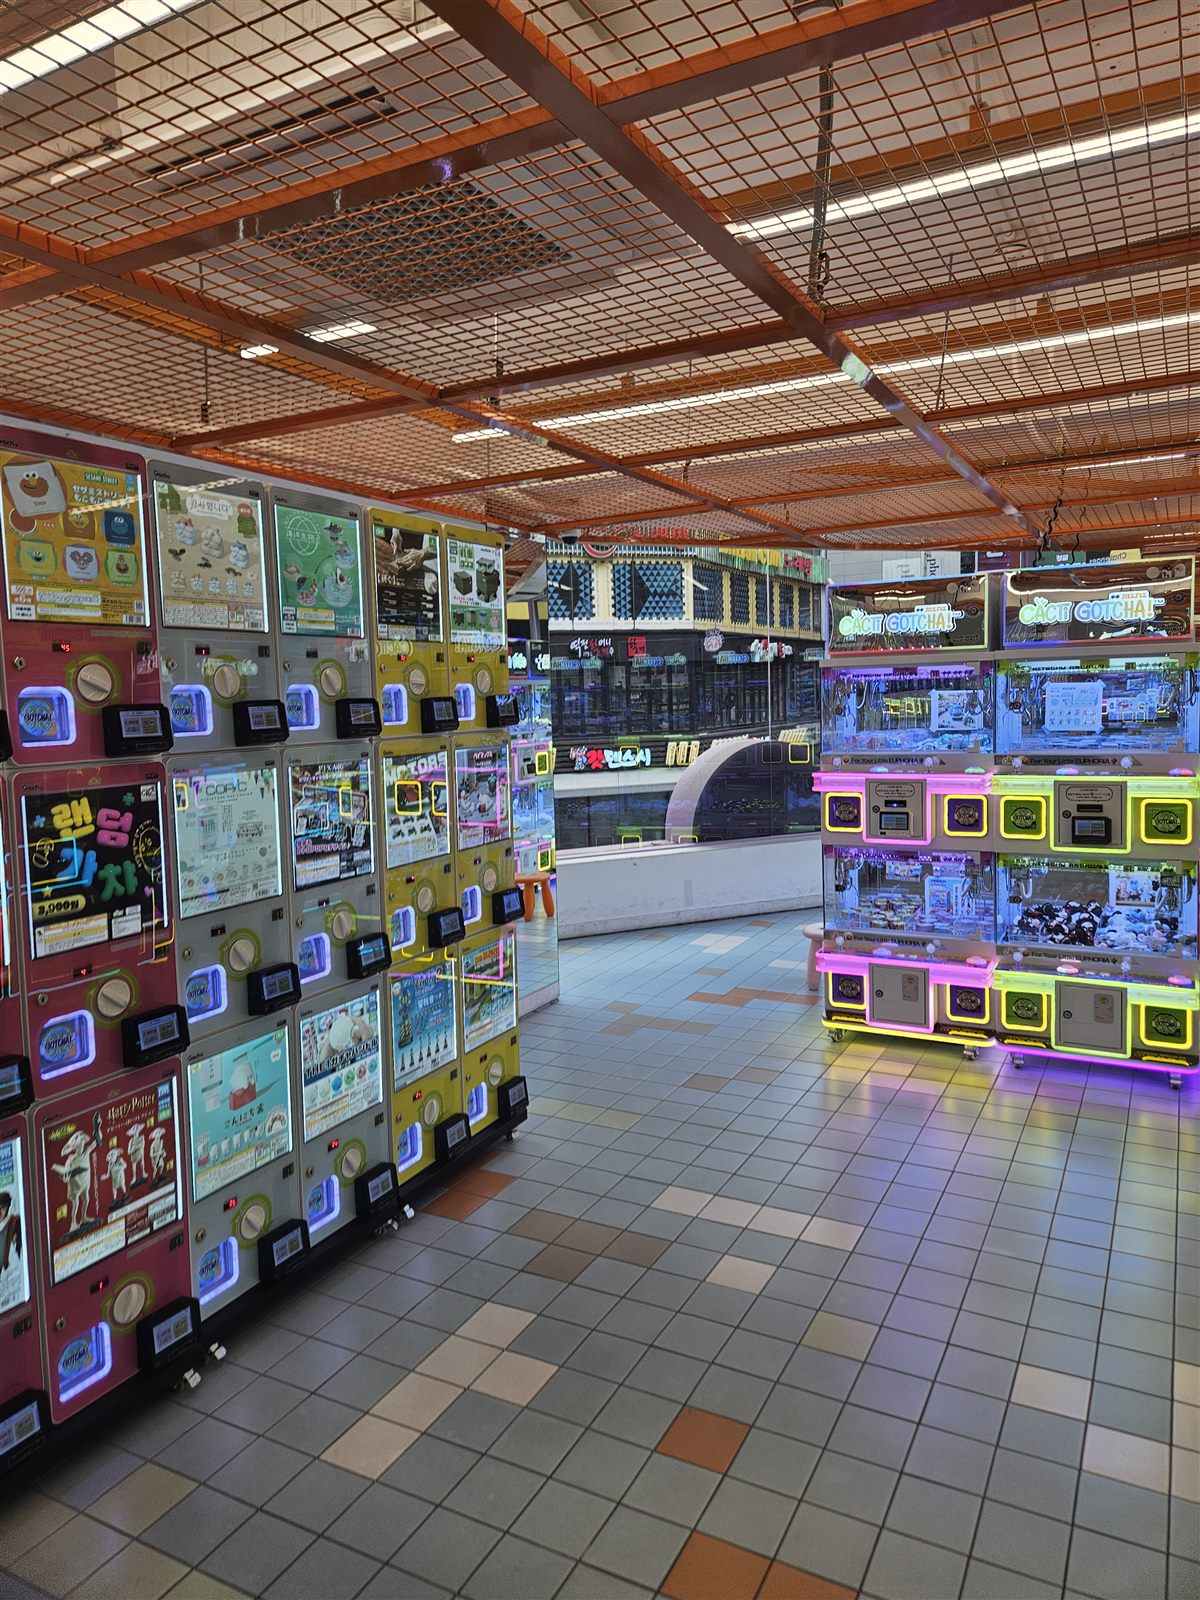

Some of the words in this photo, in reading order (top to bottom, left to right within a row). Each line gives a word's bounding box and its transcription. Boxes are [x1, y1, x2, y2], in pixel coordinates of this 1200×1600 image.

[784, 554, 812, 577] 노래방
[1075, 599, 1155, 622] GOTCHA!
[886, 611, 956, 633] GOTCHA!
[60, 643, 71, 652] 45
[889, 756, 920, 765] EUPHORIA
[1042, 757, 1058, 765] Your
[1075, 757, 1111, 765] EUPHORIA
[51, 797, 134, 848] 랜덤
[1155, 816, 1179, 826] GOTCHA!
[56, 847, 139, 900] 가차
[1075, 954, 1110, 964] EUPHORIA
[131, 1094, 156, 1113] Potter
